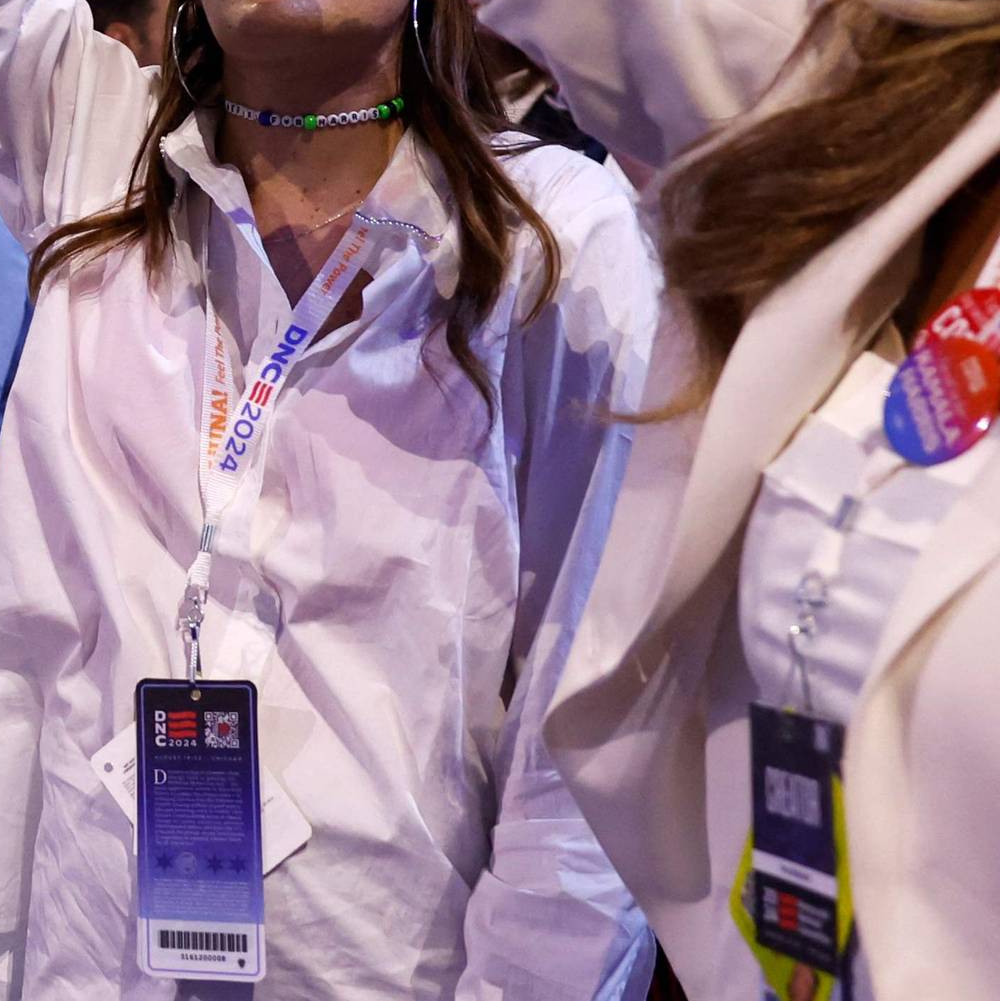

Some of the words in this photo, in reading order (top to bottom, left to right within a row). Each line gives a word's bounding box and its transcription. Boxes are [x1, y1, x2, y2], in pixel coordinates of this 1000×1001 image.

[317, 107, 379, 127] HARRIS
[261, 323, 308, 383] DNC
[219, 402, 262, 473] 2024
[168, 738, 197, 747] 2024
